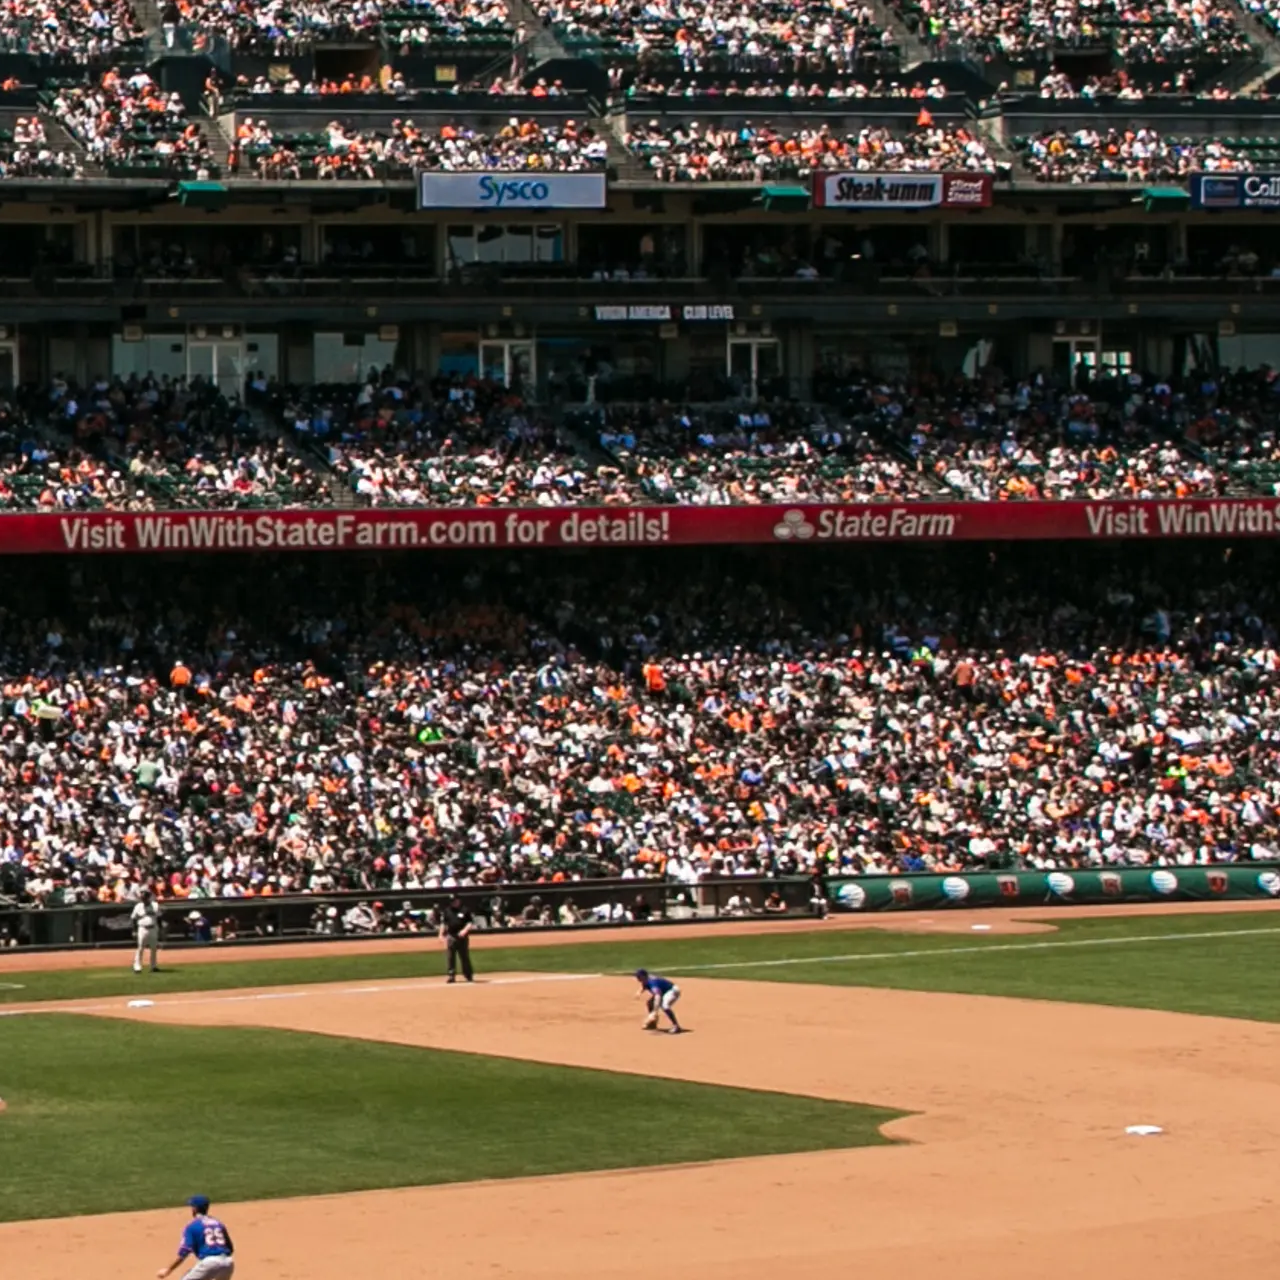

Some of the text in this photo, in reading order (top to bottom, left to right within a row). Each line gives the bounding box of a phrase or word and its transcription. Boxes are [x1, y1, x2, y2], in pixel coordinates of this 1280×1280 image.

[479, 175, 549, 205] Sysco
[834, 176, 936, 202] Steak-umm
[61, 511, 670, 549] Visit WinWithStateFarm.com for details!
[1086, 504, 1149, 535] Visit
